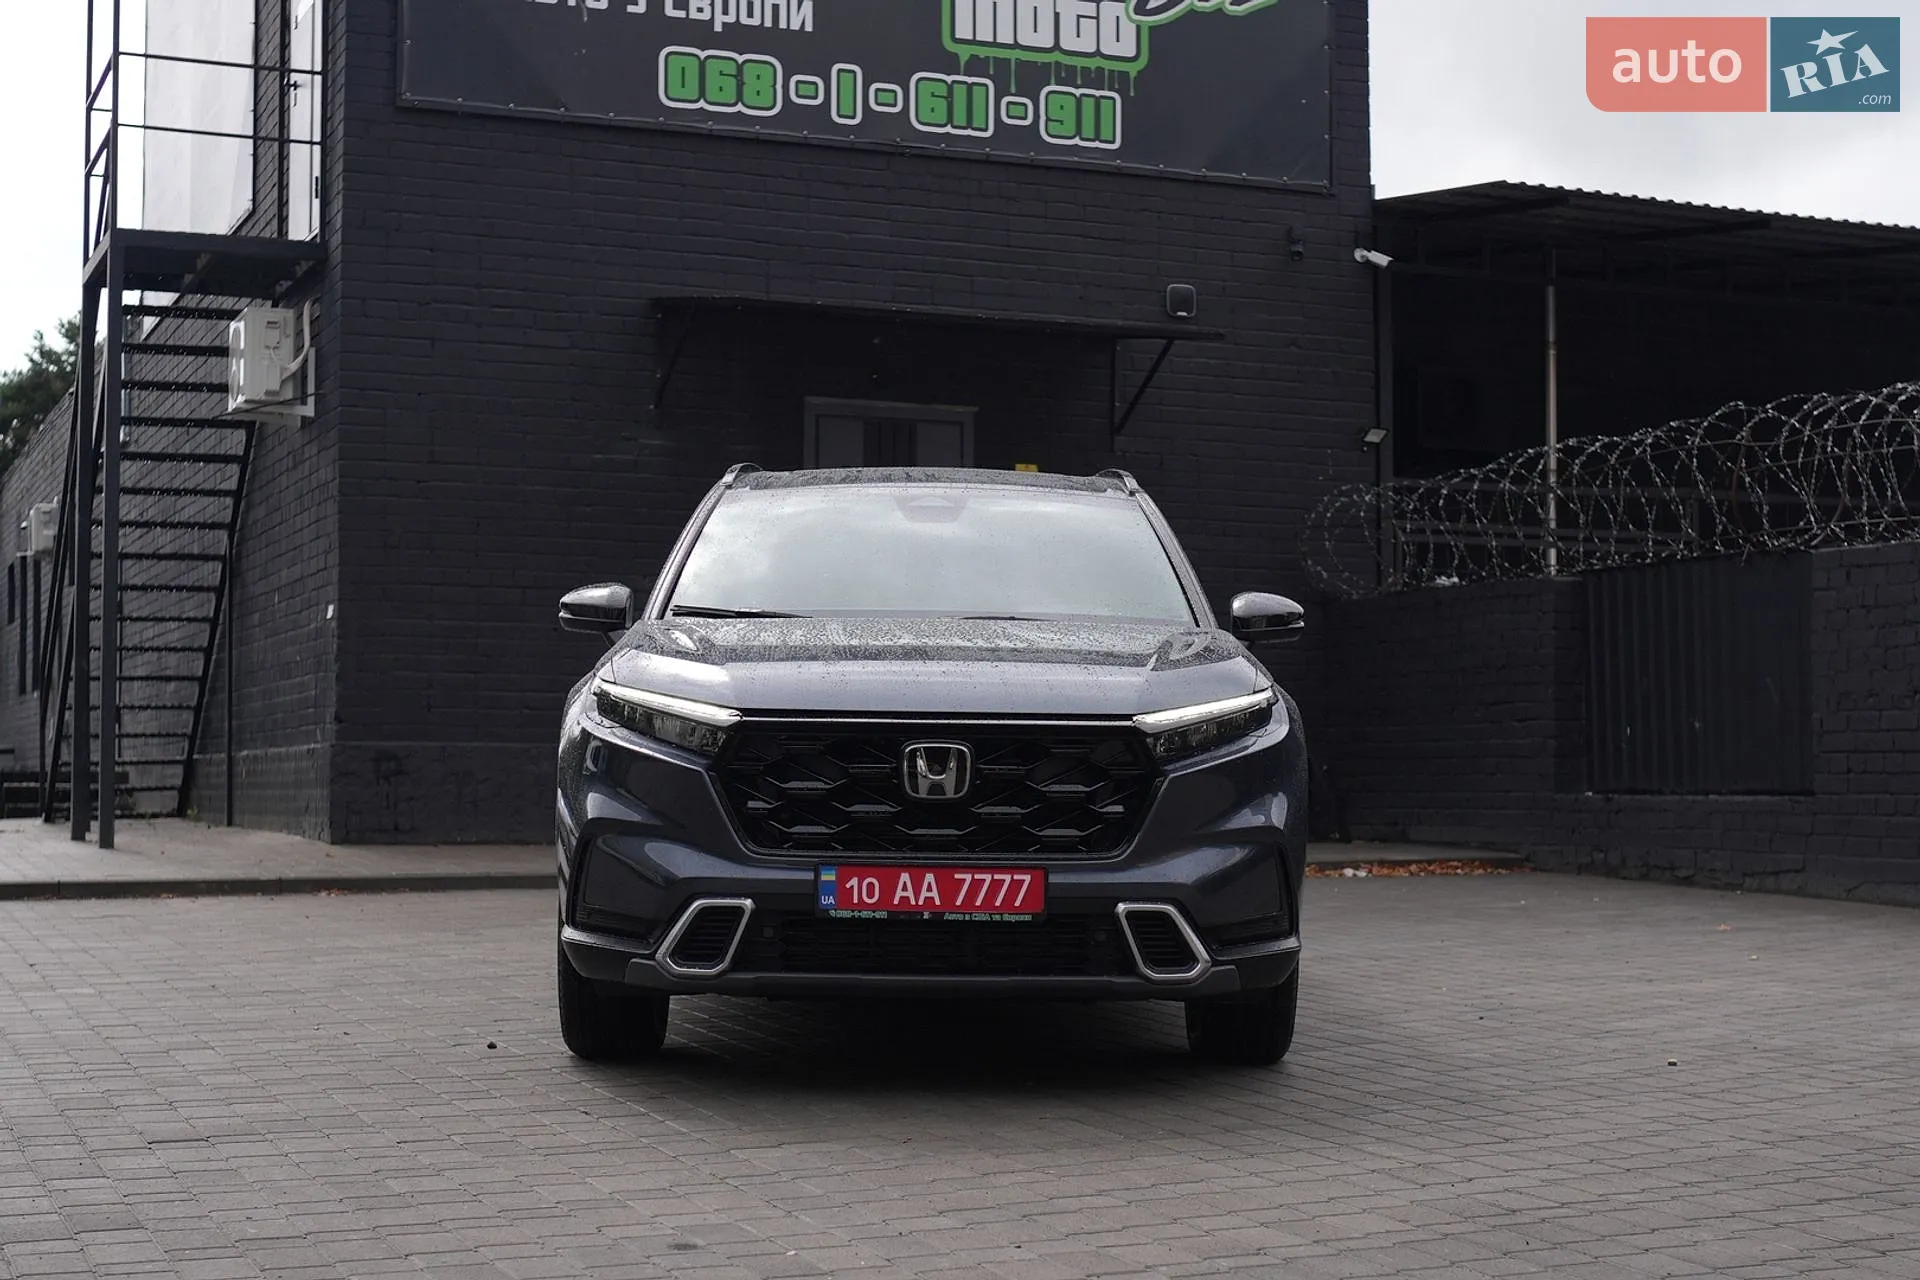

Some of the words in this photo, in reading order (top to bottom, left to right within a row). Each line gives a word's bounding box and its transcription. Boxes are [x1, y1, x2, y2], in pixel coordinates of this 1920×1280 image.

[821, 895, 836, 905] UA
[845, 876, 880, 904] 10
[893, 872, 941, 906] AA
[954, 873, 1032, 907] 7777
